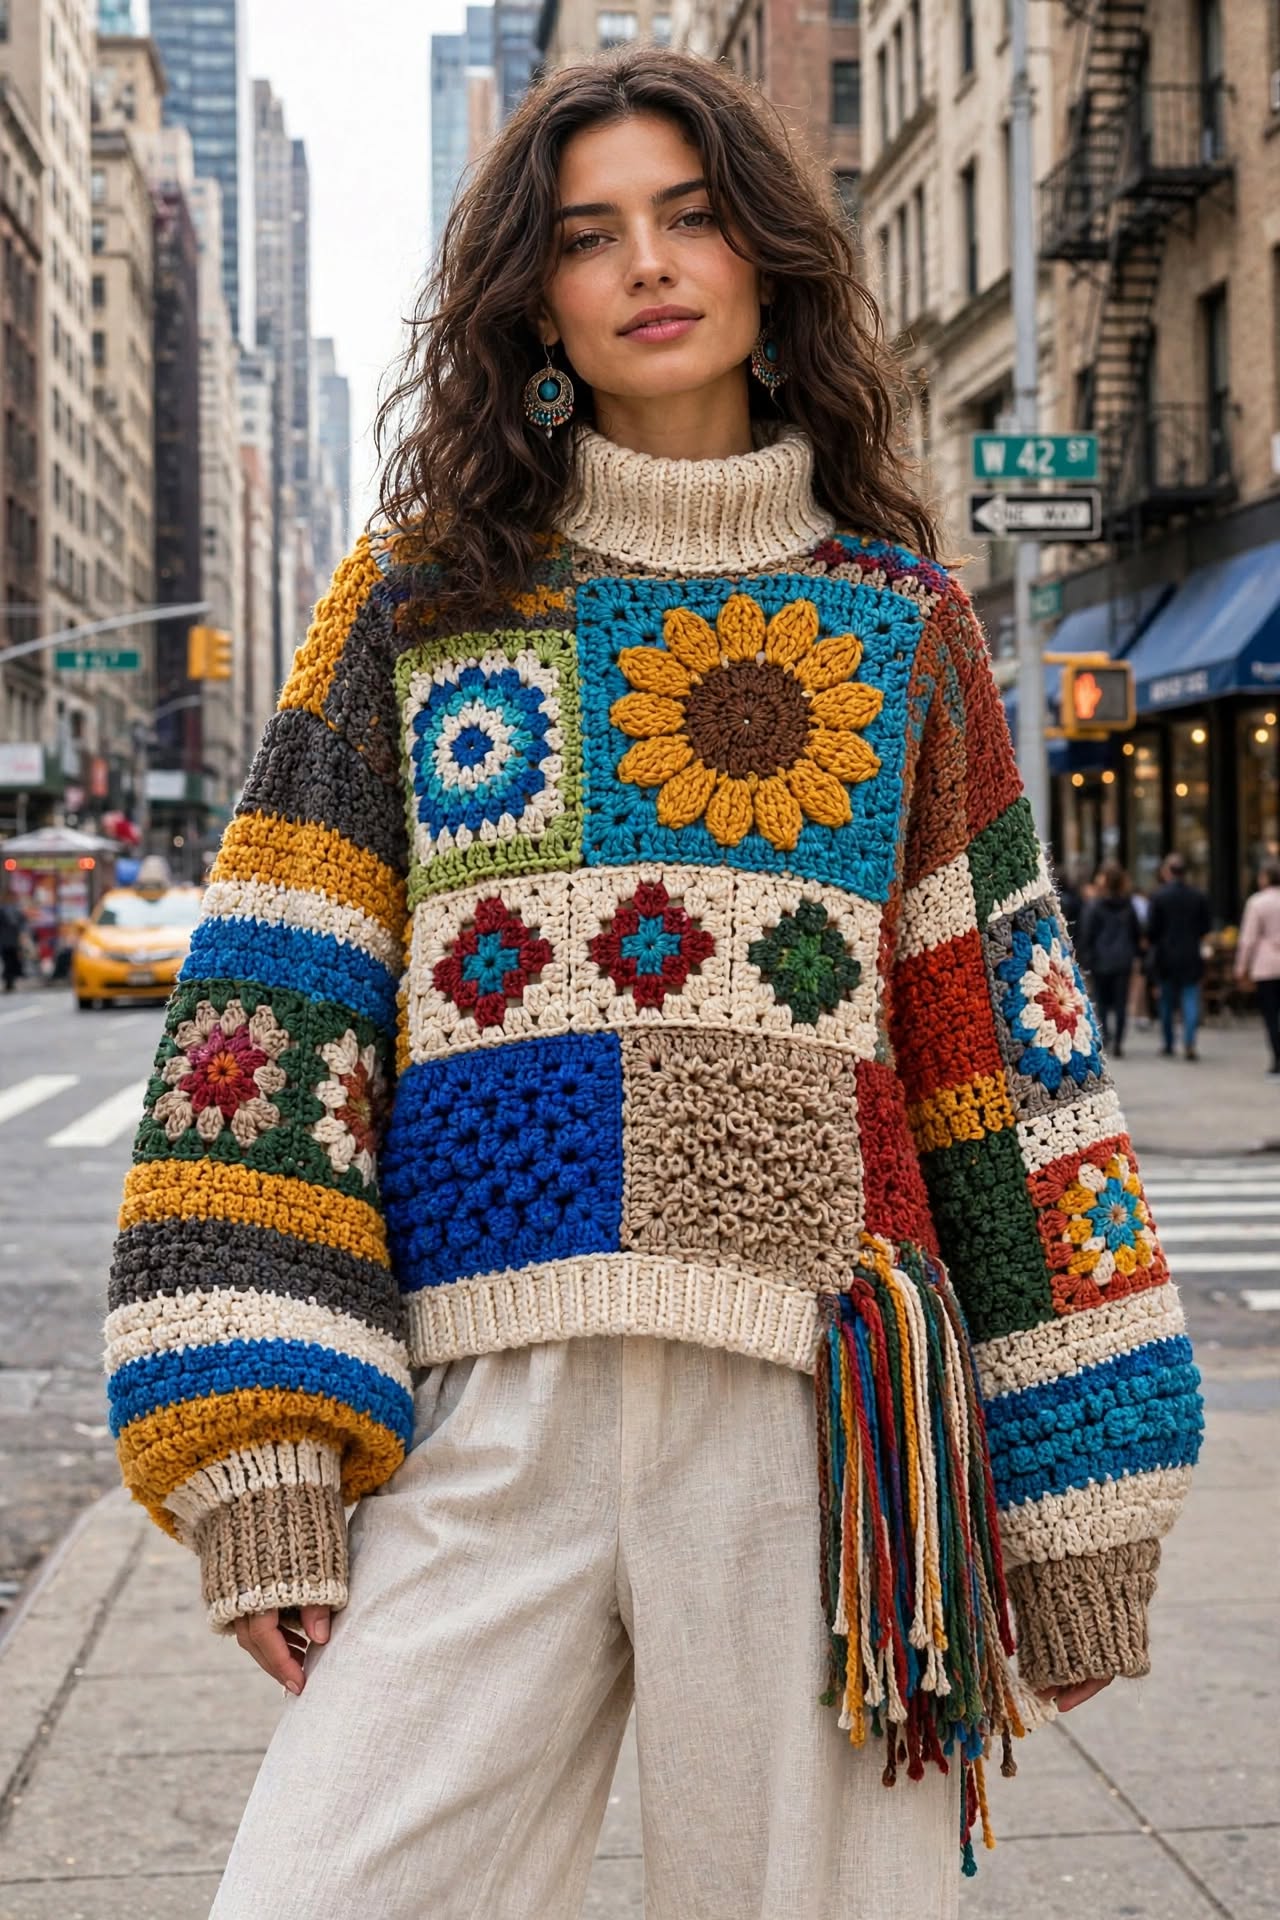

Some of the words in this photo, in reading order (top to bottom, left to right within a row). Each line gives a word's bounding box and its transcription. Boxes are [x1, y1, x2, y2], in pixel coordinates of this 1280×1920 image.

[981, 441, 1007, 474] W
[1016, 440, 1056, 475] 42
[1066, 439, 1090, 463] ST
